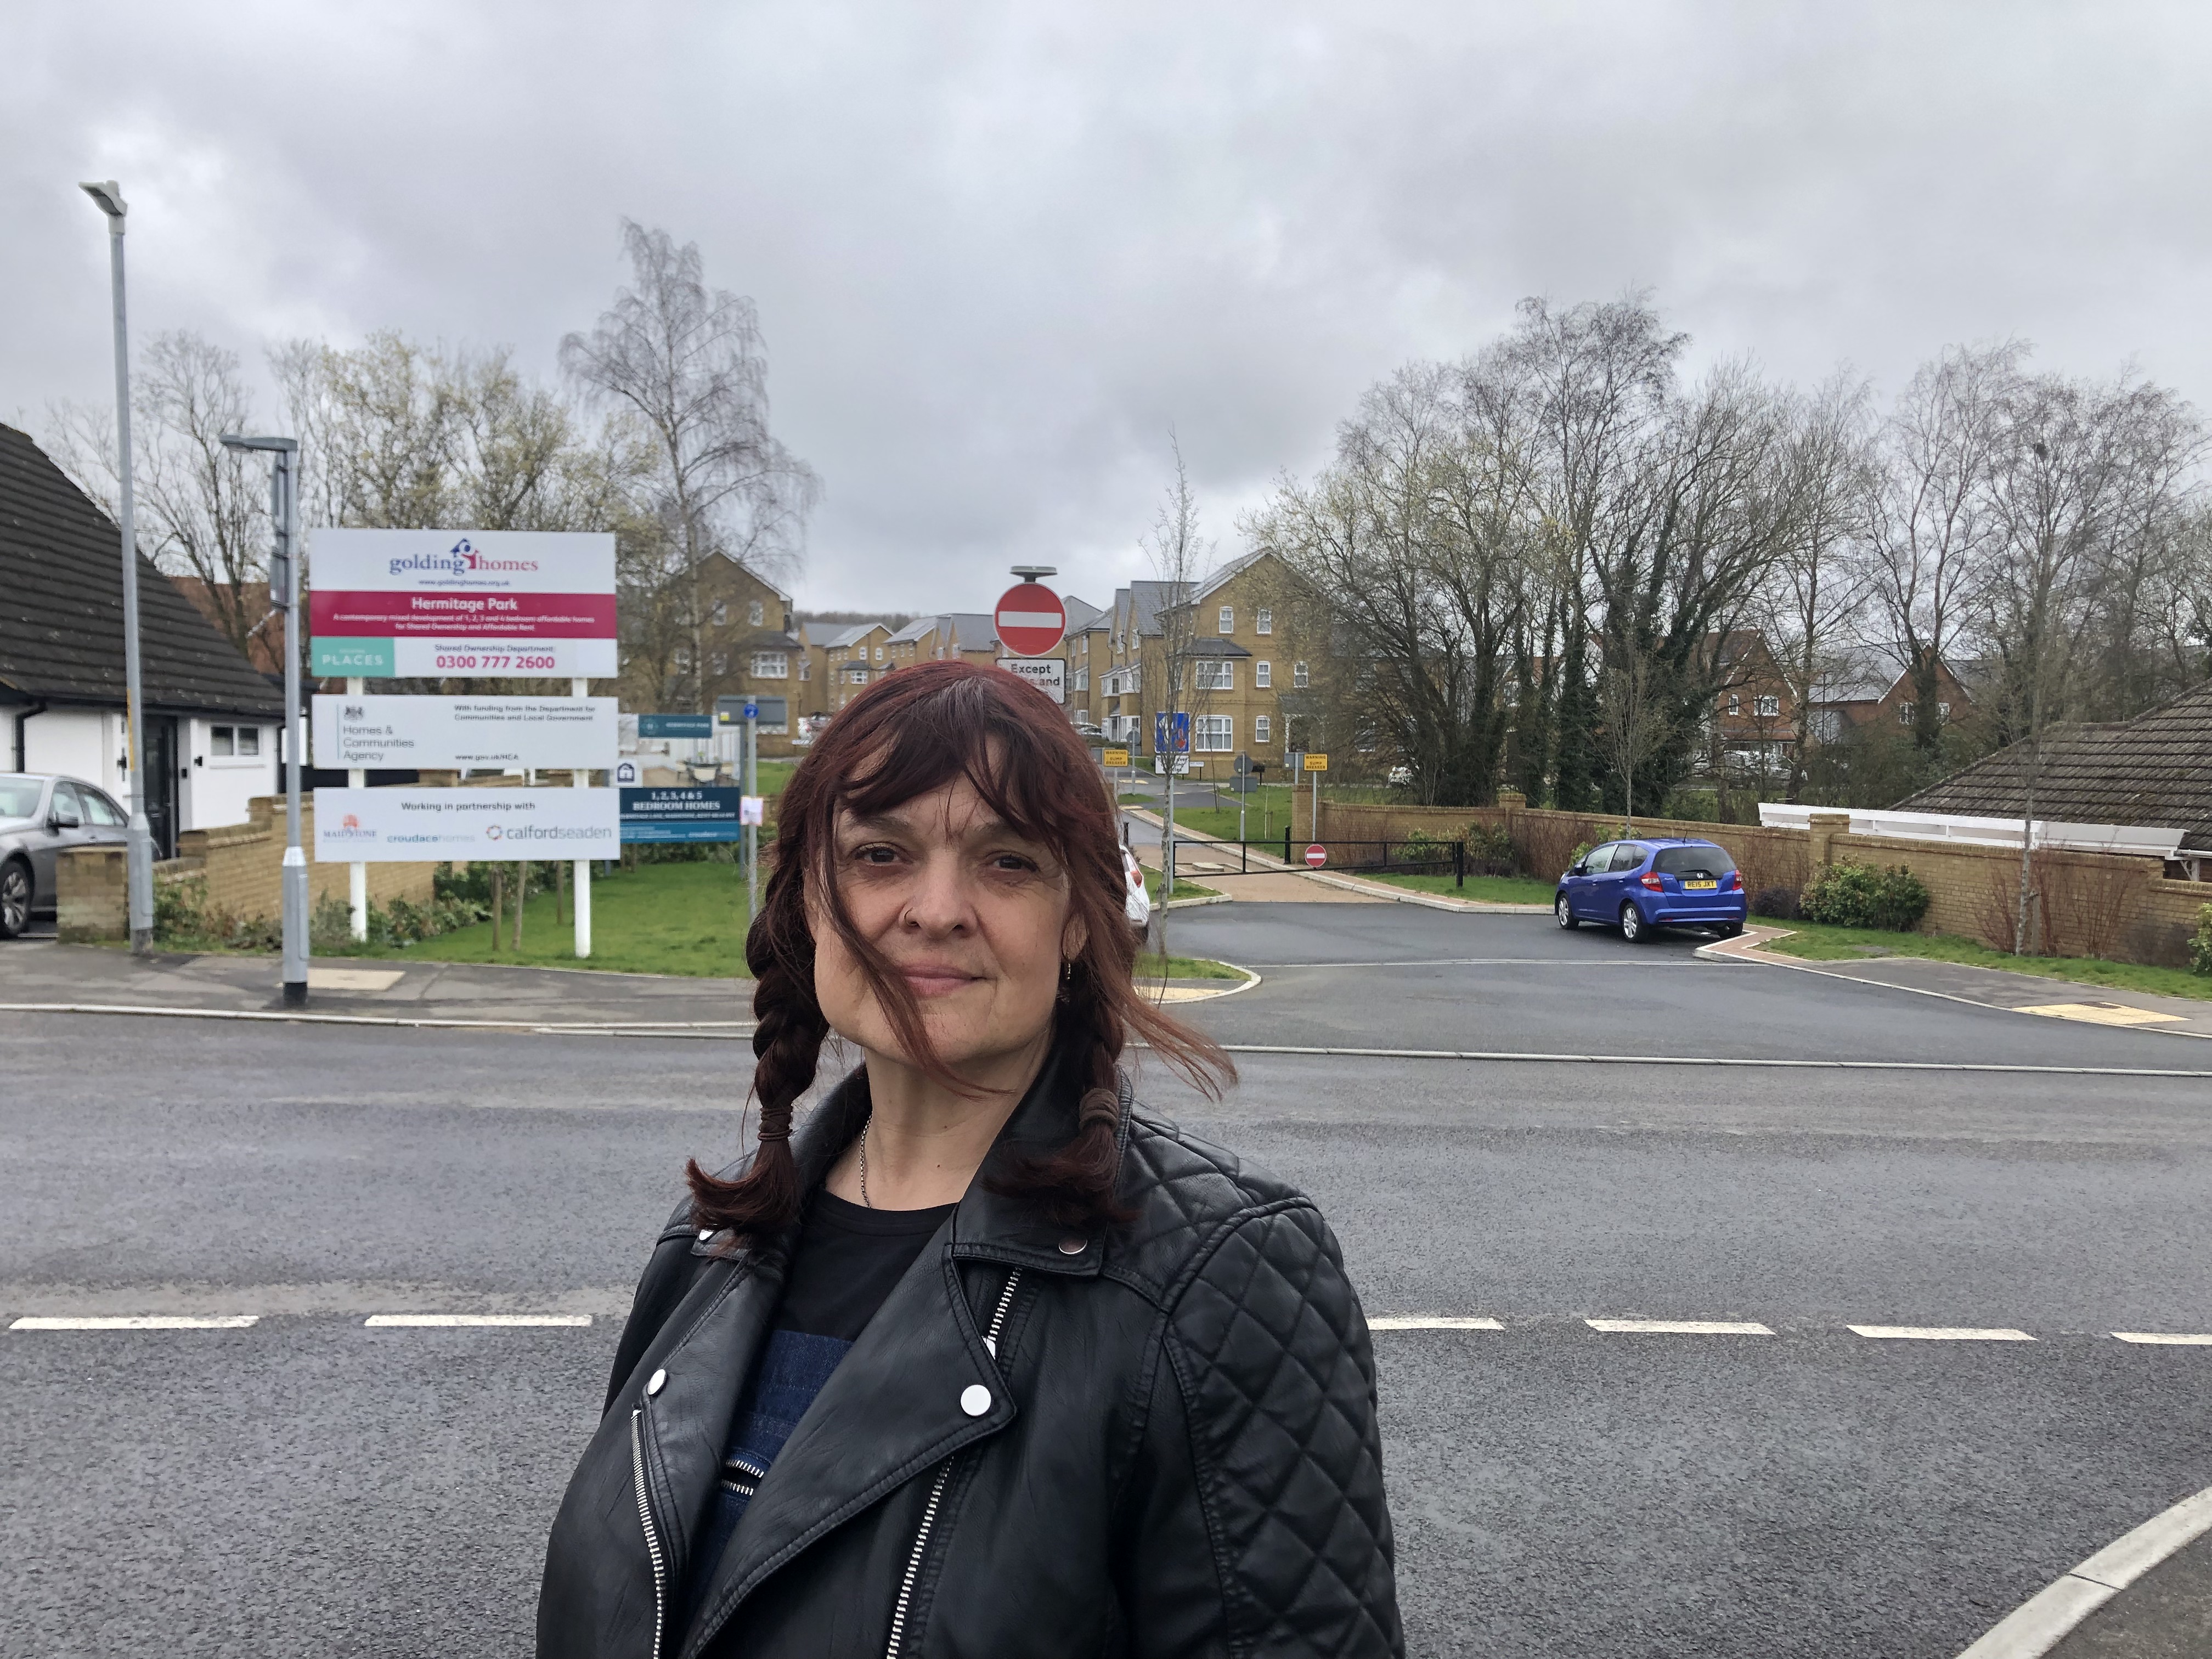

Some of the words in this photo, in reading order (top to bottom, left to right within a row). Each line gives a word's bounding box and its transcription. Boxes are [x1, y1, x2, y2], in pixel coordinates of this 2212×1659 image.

[390, 554, 465, 575] golding
[479, 556, 538, 571] homes
[412, 596, 484, 613] Hermitage
[488, 597, 518, 611] Park
[411, 614, 454, 623] development
[464, 644, 505, 653] Ownership
[507, 645, 554, 653] Department
[322, 654, 383, 666] PLACES
[436, 656, 476, 668] 0300
[482, 656, 511, 668] 777
[516, 656, 555, 669] 2600
[1011, 663, 1051, 675] Except
[1039, 676, 1060, 686] and
[474, 704, 503, 712] funding
[343, 725, 382, 735] Homes
[385, 725, 393, 735] &
[343, 737, 415, 748] Communities
[343, 750, 384, 763] Agency
[401, 802, 442, 812] Working
[444, 802, 453, 810] in
[456, 802, 512, 812] partnership
[515, 802, 535, 810] with
[633, 801, 683, 811] BEDROOM
[685, 800, 721, 810] HOMES
[506, 824, 612, 840] calfordseaden
